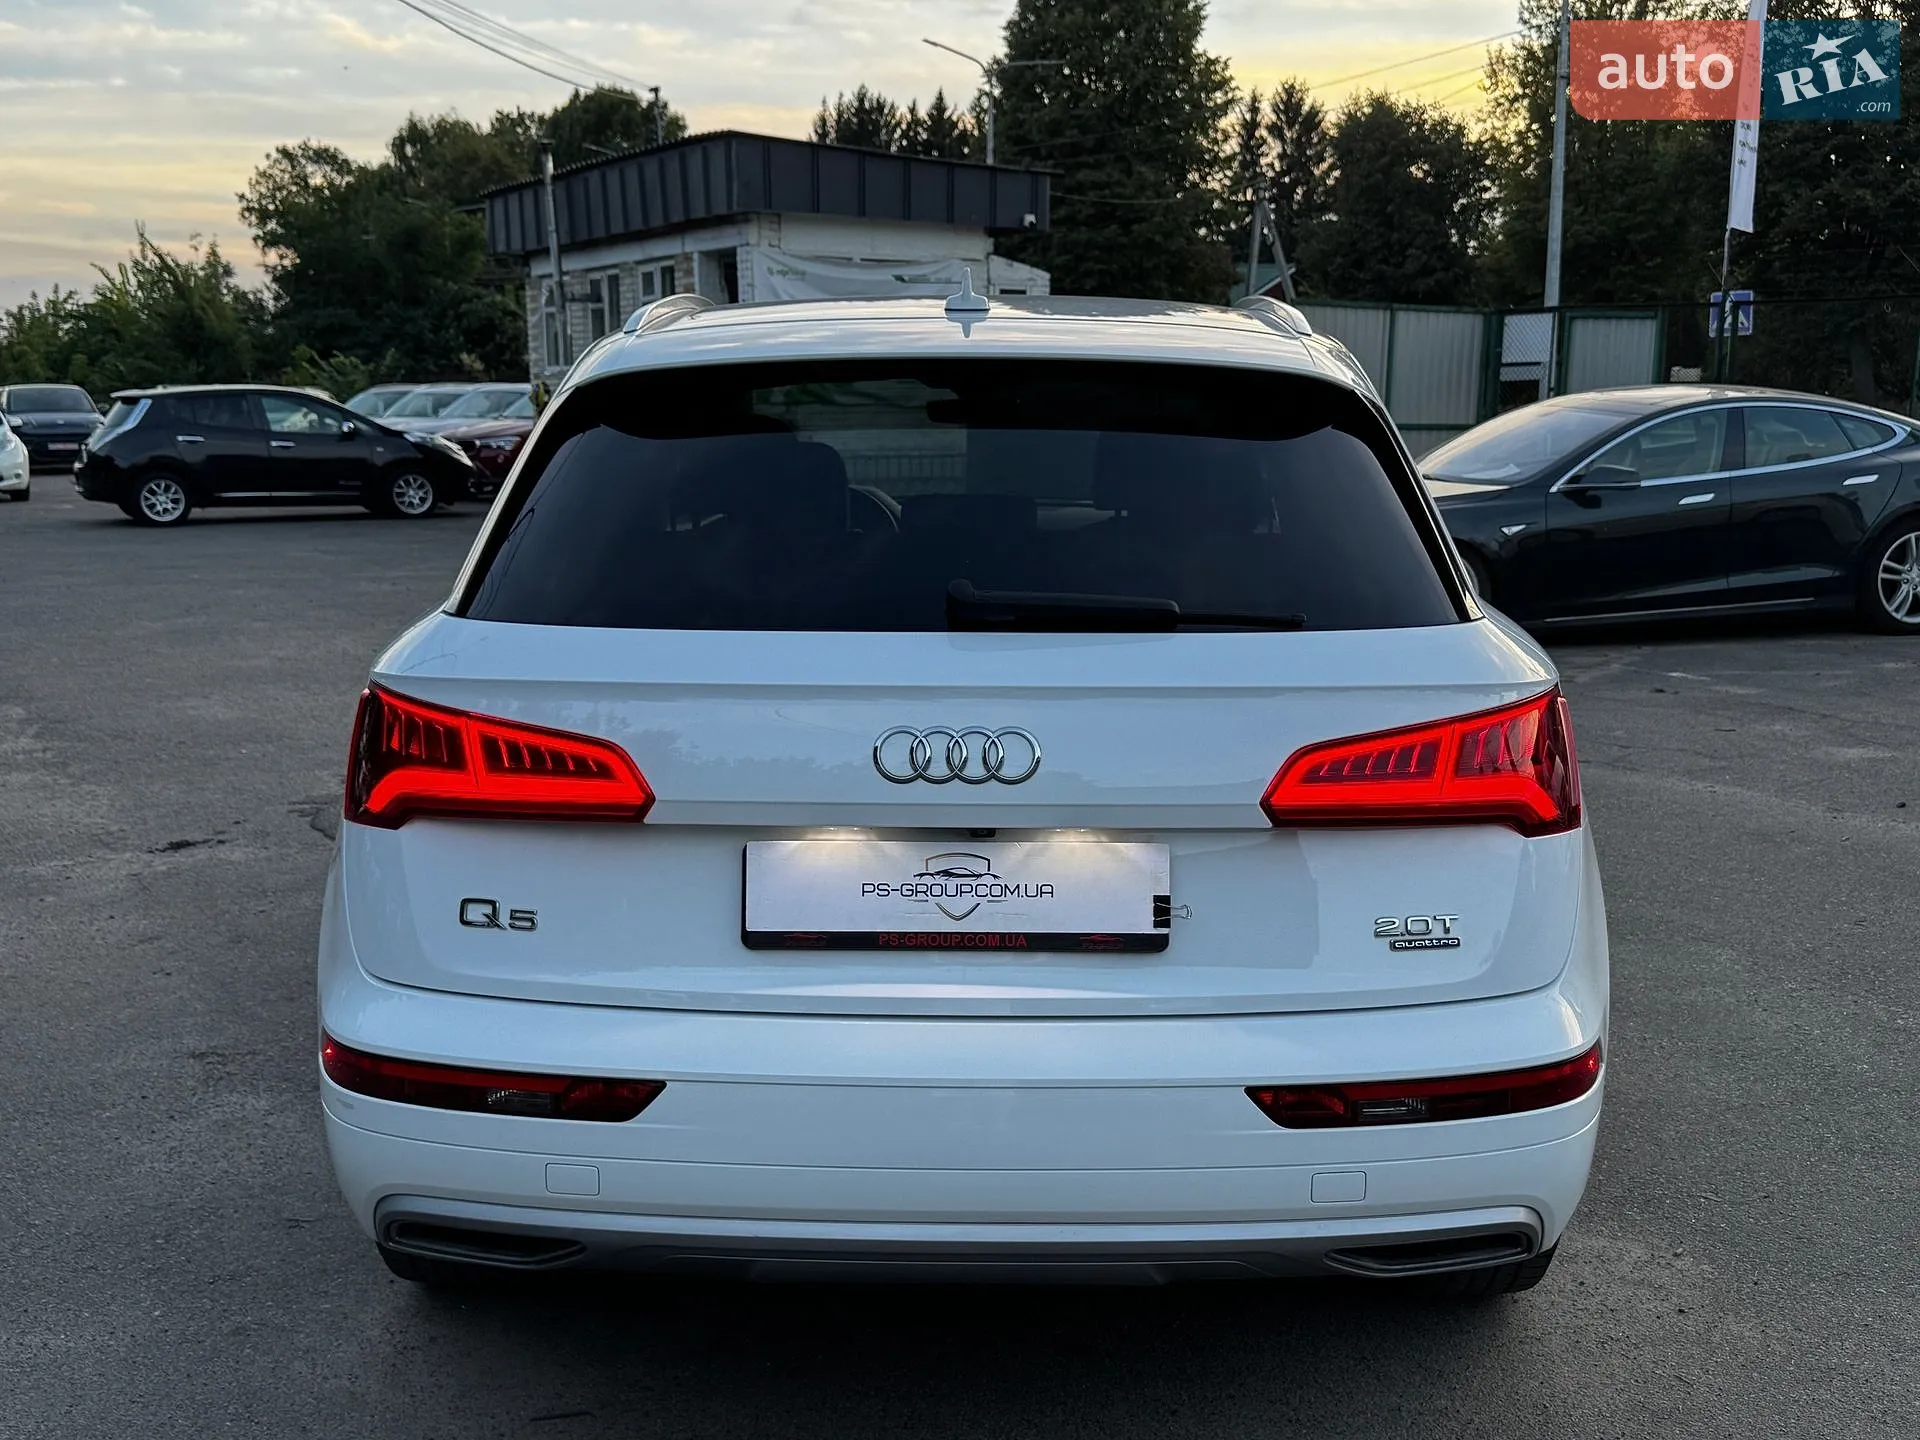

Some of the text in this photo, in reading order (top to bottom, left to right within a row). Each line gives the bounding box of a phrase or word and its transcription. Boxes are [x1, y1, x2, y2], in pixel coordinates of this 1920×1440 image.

[861, 882, 1055, 899] PS-GROUP.COM.UA
[459, 897, 539, 932] Q5
[1374, 914, 1460, 938] 2.0T
[878, 932, 1028, 948] PS-GROUP.COM.UA
[1394, 938, 1459, 949] quattro
